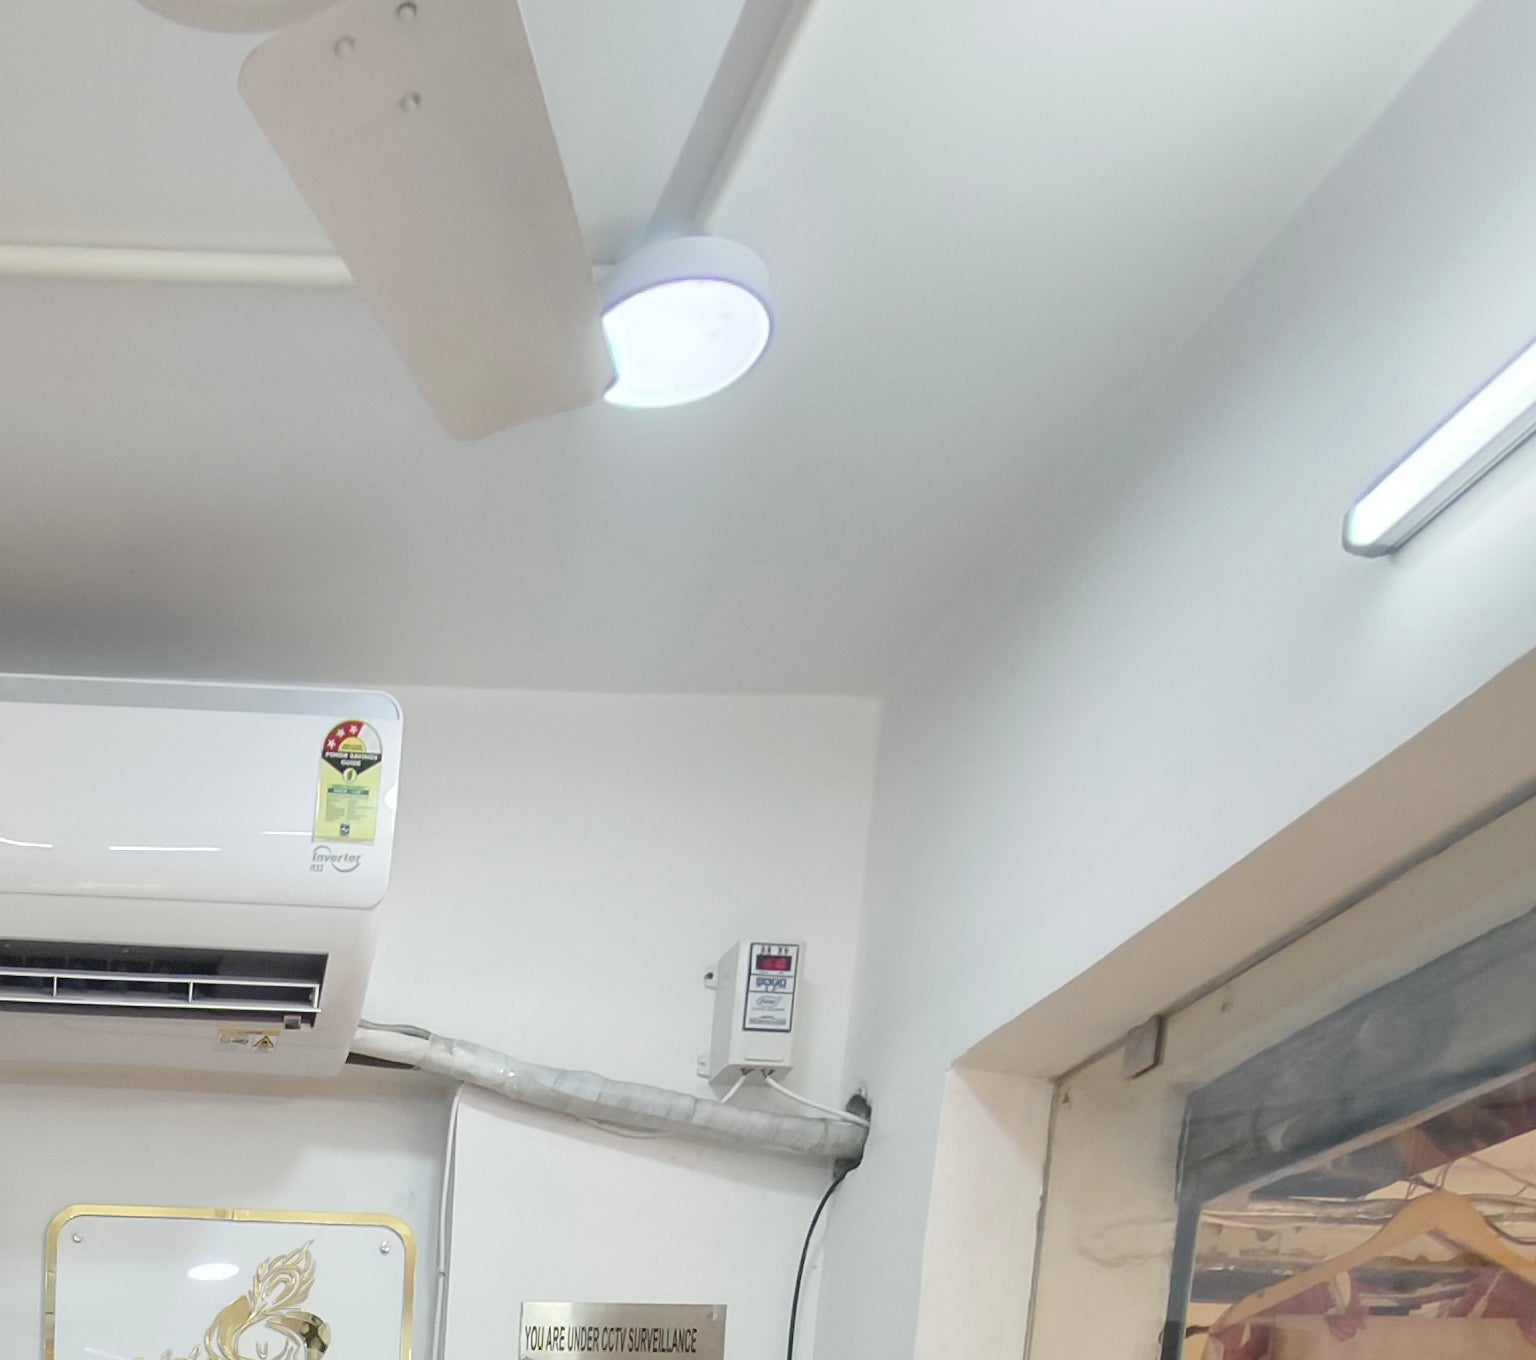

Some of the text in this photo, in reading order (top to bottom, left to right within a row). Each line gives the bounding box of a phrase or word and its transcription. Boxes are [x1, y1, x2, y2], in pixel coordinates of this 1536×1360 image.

[524, 1326, 698, 1354] YOU ARE UNDER CCTV SURVEILLANCE
